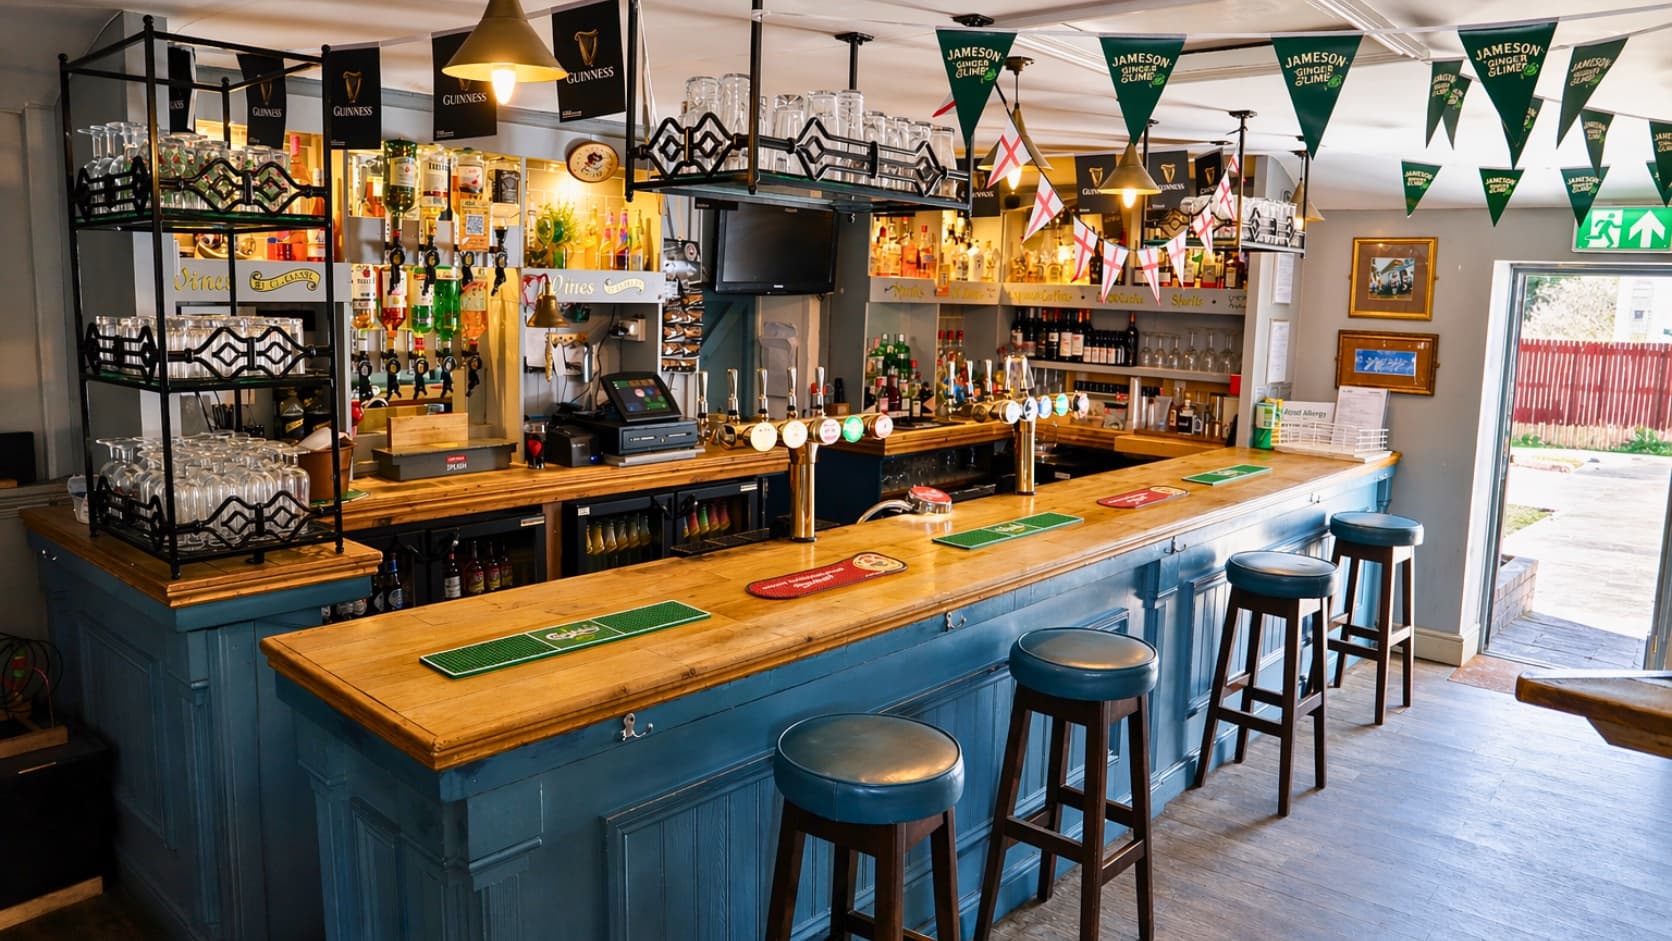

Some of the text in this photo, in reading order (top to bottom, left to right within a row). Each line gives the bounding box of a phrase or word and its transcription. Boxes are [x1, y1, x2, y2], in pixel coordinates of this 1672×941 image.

[947, 46, 1002, 63] JAMESON
[1475, 42, 1541, 61] JAMESON
[956, 59, 989, 69] GINGER
[1112, 53, 1170, 69] JAMESON
[1285, 52, 1347, 68] JAMESON
[1487, 54, 1527, 68] GINGER
[1571, 57, 1611, 72] JAMESON
[566, 66, 615, 84] GUINNESS
[1121, 65, 1157, 74] GINGER
[1295, 64, 1333, 77] GINGER
[442, 92, 488, 106] GUINNESS
[252, 105, 282, 118] GUINNESS
[333, 105, 373, 117] GUINNESS
[1302, 409, 1328, 419] Allergy
